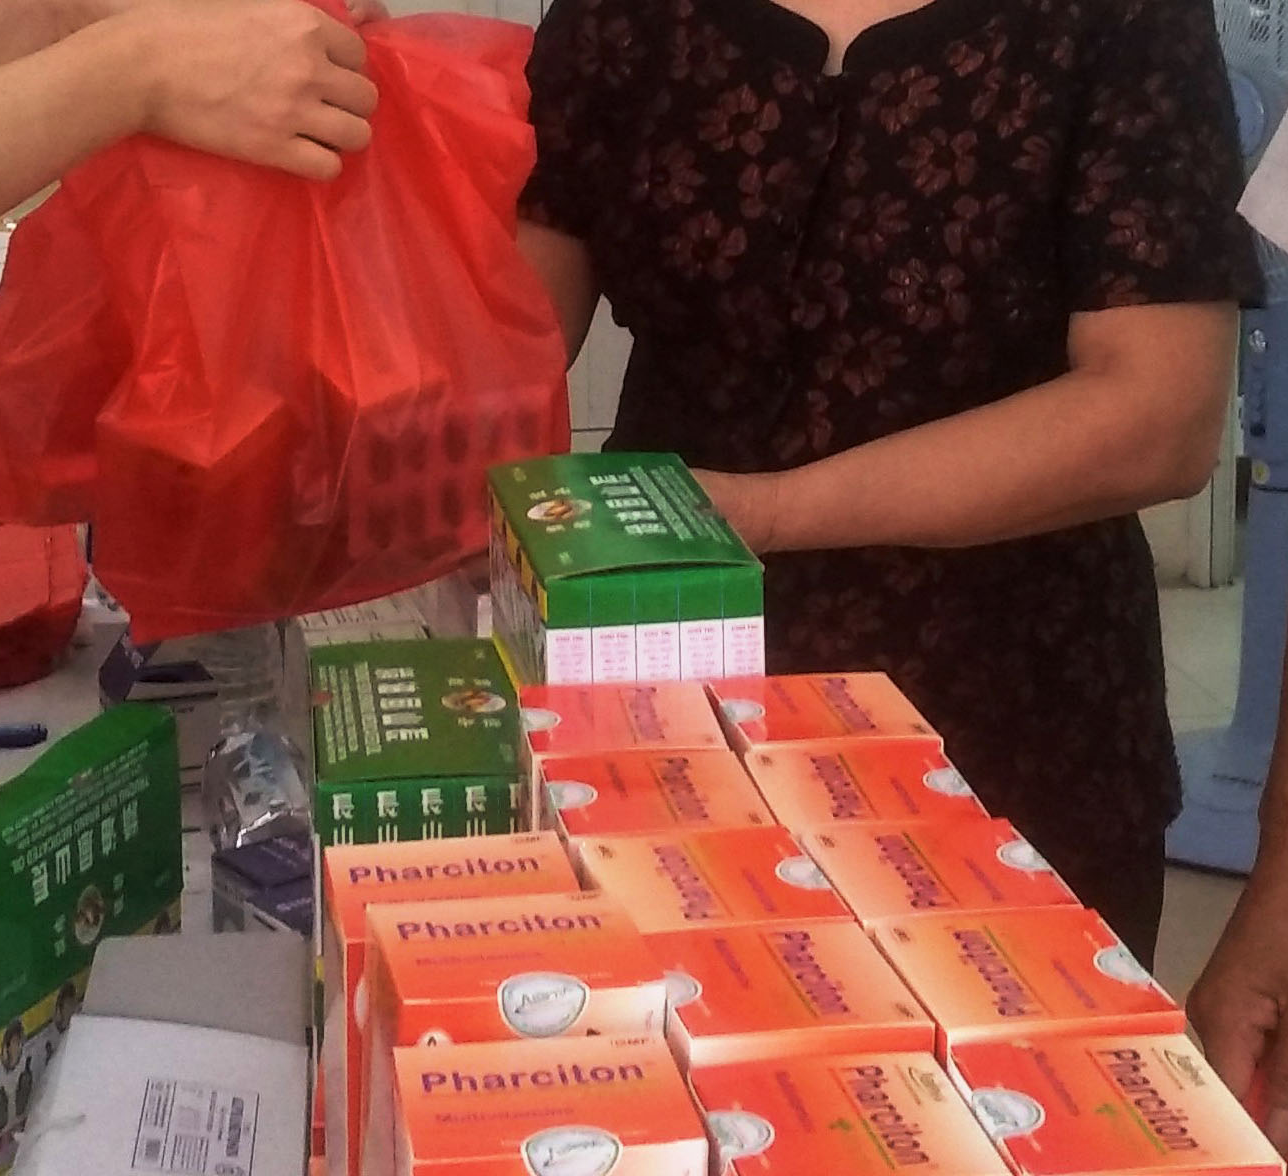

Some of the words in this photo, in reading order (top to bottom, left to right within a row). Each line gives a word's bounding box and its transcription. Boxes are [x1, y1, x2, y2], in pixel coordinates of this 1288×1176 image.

[349, 855, 540, 884] Pharciton
[397, 913, 601, 941] Pharciton
[421, 1064, 644, 1093] Pharciton
[1097, 1048, 1199, 1153] Pharciton
